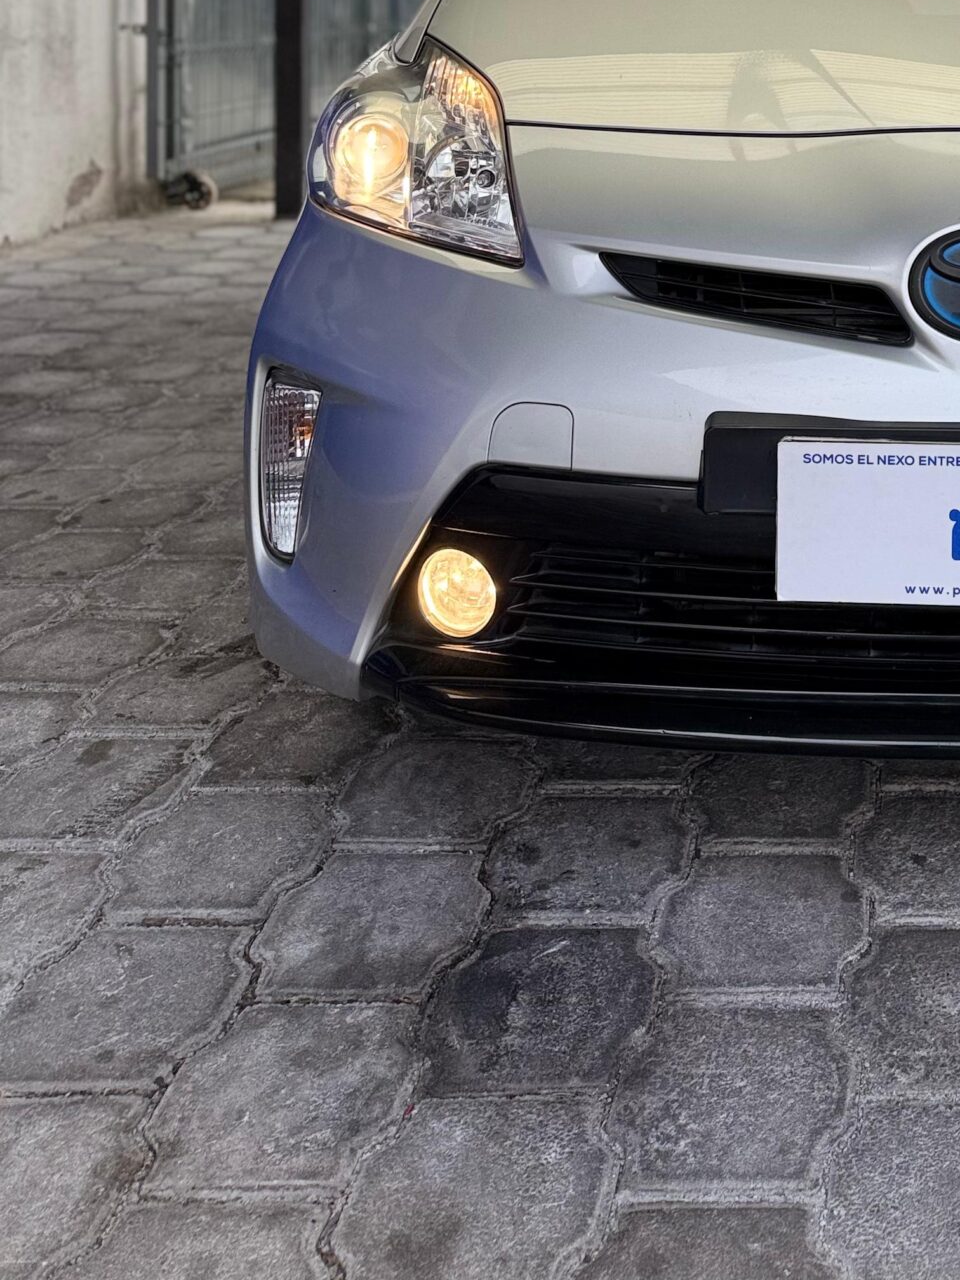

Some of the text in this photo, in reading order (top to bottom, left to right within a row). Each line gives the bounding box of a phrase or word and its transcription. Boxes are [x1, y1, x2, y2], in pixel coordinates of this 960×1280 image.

[803, 453, 854, 465] SOMOS
[857, 454, 874, 465] EL
[877, 455, 915, 466] NEXO
